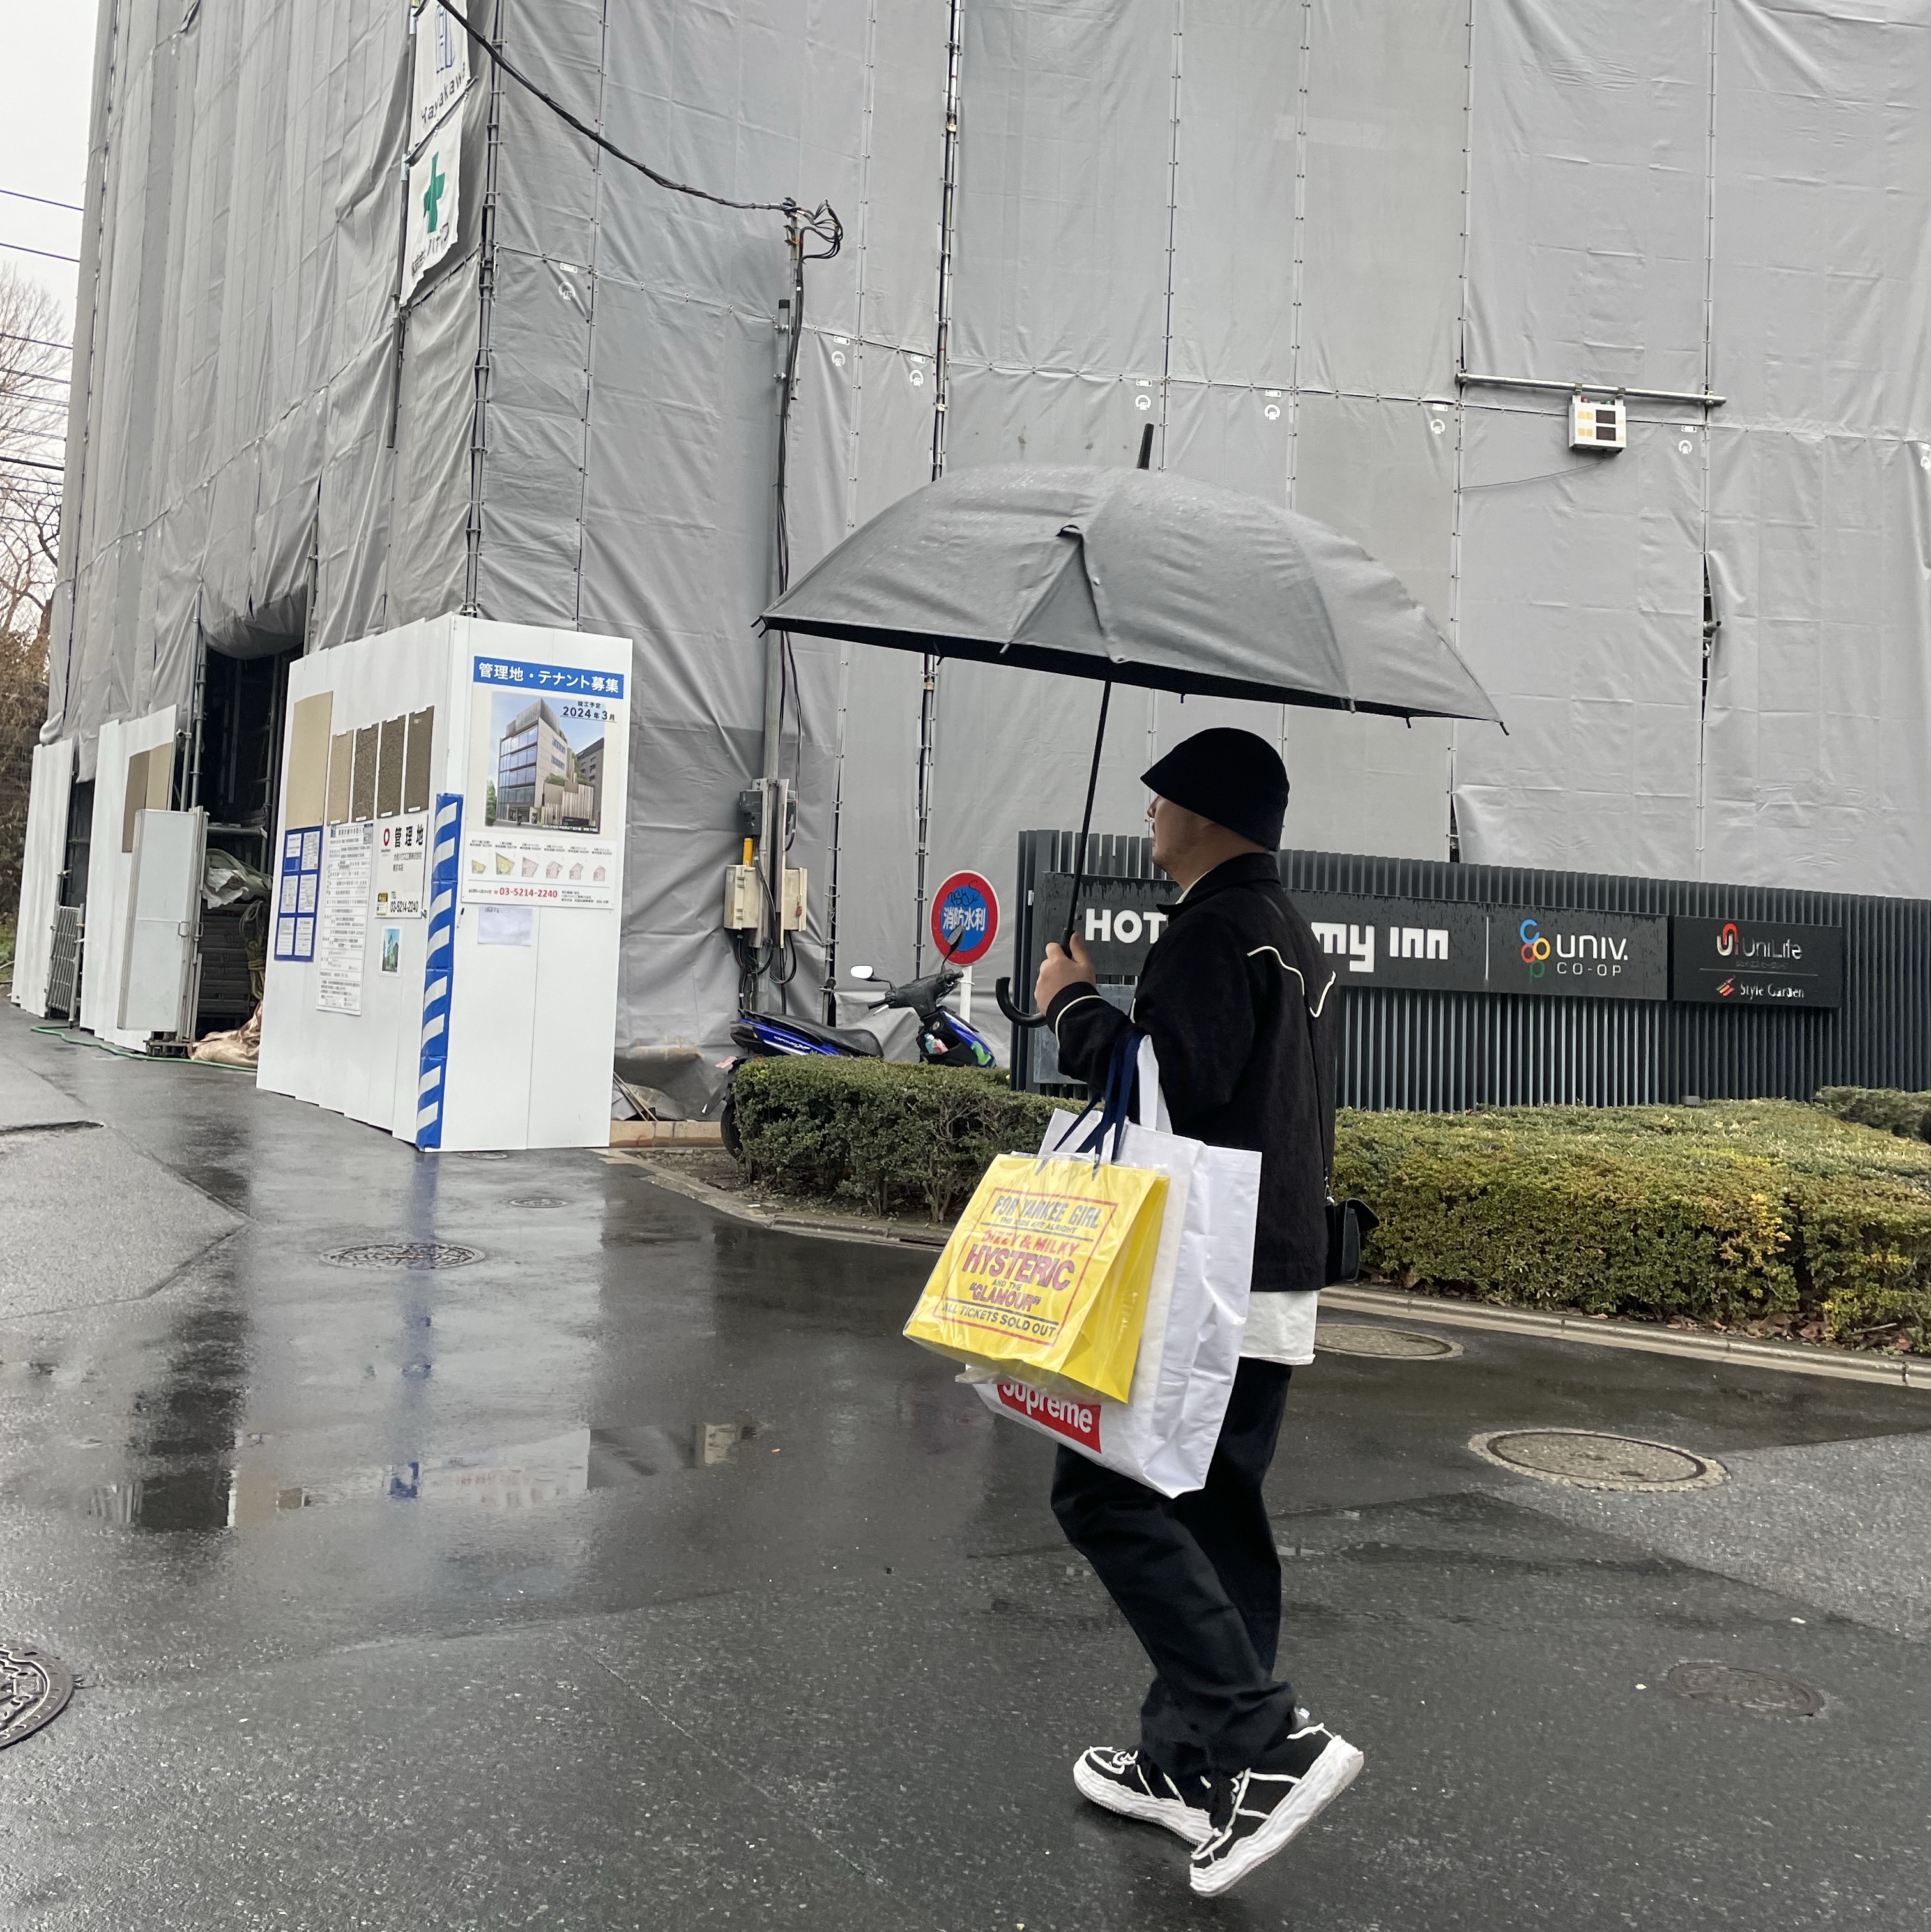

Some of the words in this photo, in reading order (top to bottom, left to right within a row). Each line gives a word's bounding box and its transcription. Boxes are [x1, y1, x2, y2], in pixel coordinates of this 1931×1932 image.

[478, 662, 619, 694] 管理地・テナント募集
[500, 887, 558, 898] 03-5214-2240
[390, 901, 418, 913] 03-5214-2240
[943, 906, 986, 931] 消防水利
[1557, 962, 1621, 977] CO-OP
[1740, 982, 1764, 1000] Style
[1767, 983, 1805, 998] Garden
[991, 1195, 1020, 1215] FOR
[1022, 1198, 1069, 1222] YANKEE
[1068, 1204, 1103, 1229] GIRL
[1044, 1222, 1078, 1234] ALRIGHT
[981, 1229, 1021, 1247] DIZZY
[1019, 1235, 1032, 1250] &
[1032, 1236, 1080, 1257] MILKY
[961, 1244, 1075, 1291] HYSTERIC
[991, 1279, 1007, 1287] AND
[1009, 1282, 1023, 1291] THE
[942, 1302, 958, 1314] ALL
[959, 1305, 999, 1323] TICKETS
[999, 1314, 1031, 1331] SOLD
[1032, 1323, 1057, 1337] OUT
